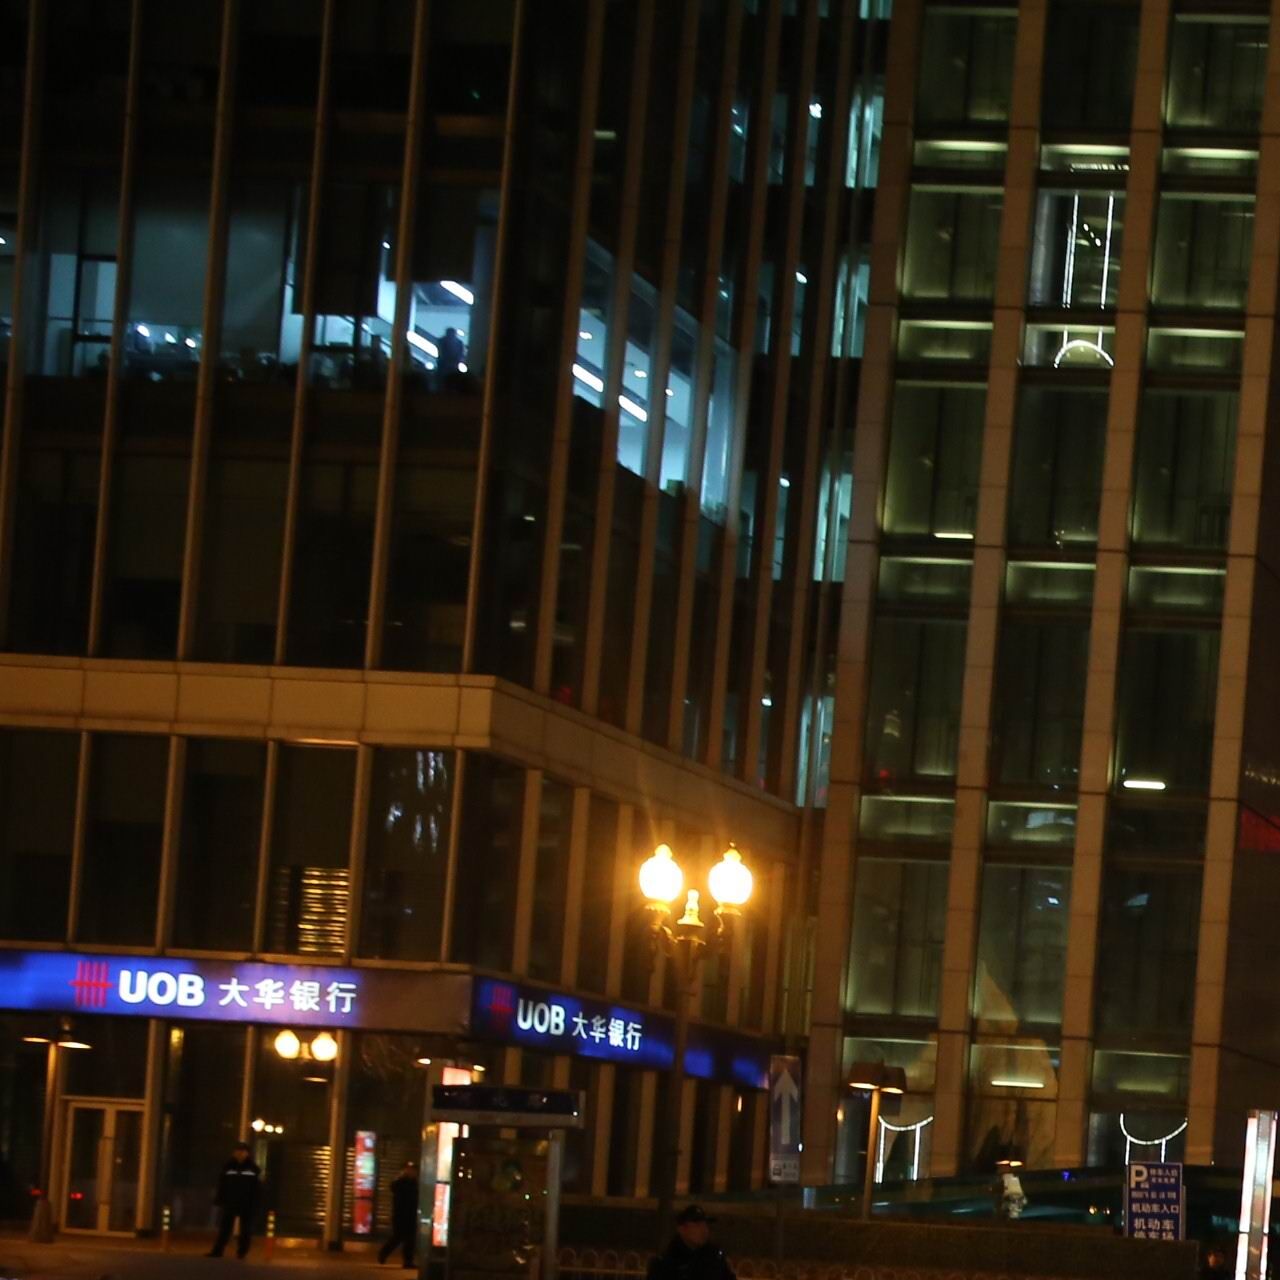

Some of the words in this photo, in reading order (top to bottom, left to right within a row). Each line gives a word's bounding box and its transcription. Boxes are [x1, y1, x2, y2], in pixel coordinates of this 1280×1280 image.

[118, 970, 205, 1007] UOB
[219, 978, 357, 1013] 大华银行
[517, 998, 566, 1036] UOB
[572, 1011, 643, 1051] 大华银行
